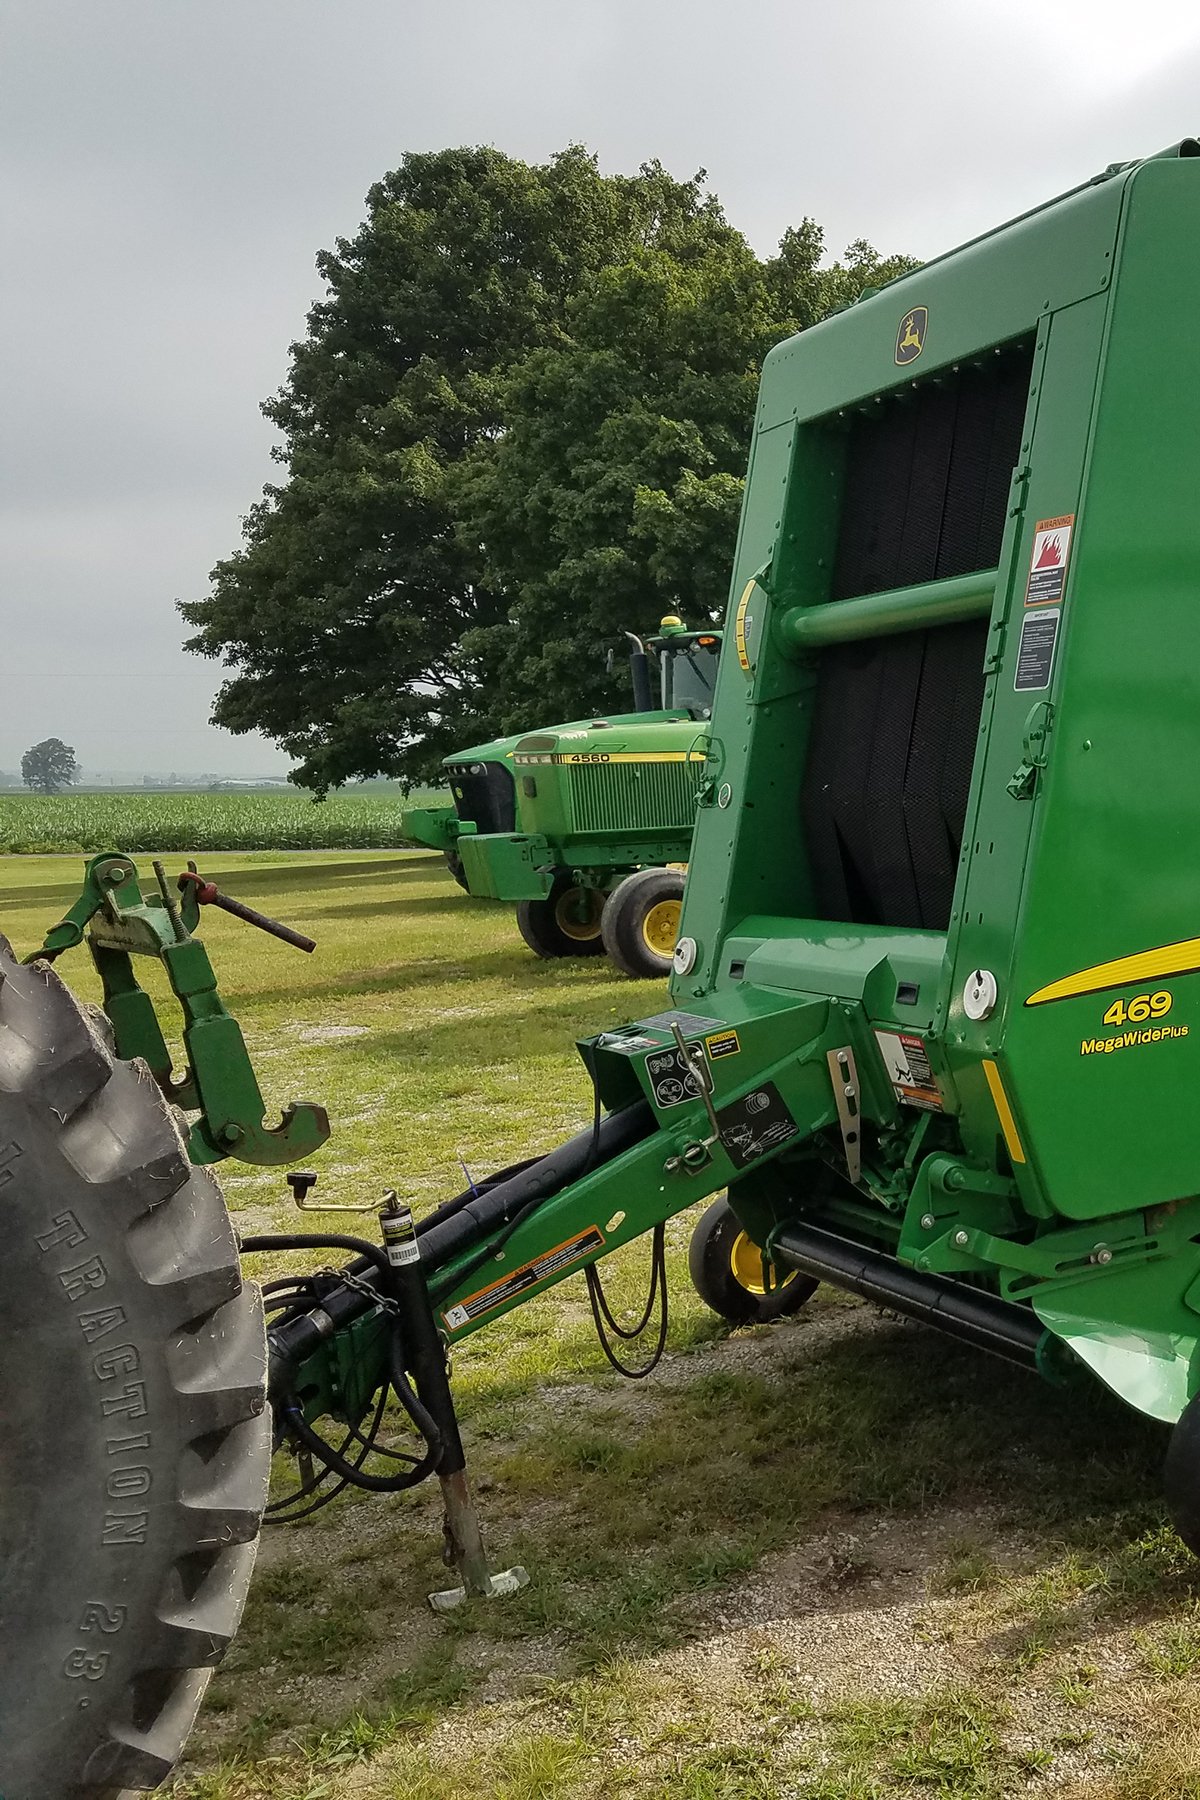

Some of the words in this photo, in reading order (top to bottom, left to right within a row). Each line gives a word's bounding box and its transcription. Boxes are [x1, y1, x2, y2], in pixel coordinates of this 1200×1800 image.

[571, 754, 610, 763] 4560
[1103, 990, 1172, 1026] 469
[1080, 1025, 1189, 1055] MegaWidePlus
[33, 1209, 153, 1547] TRACTION
